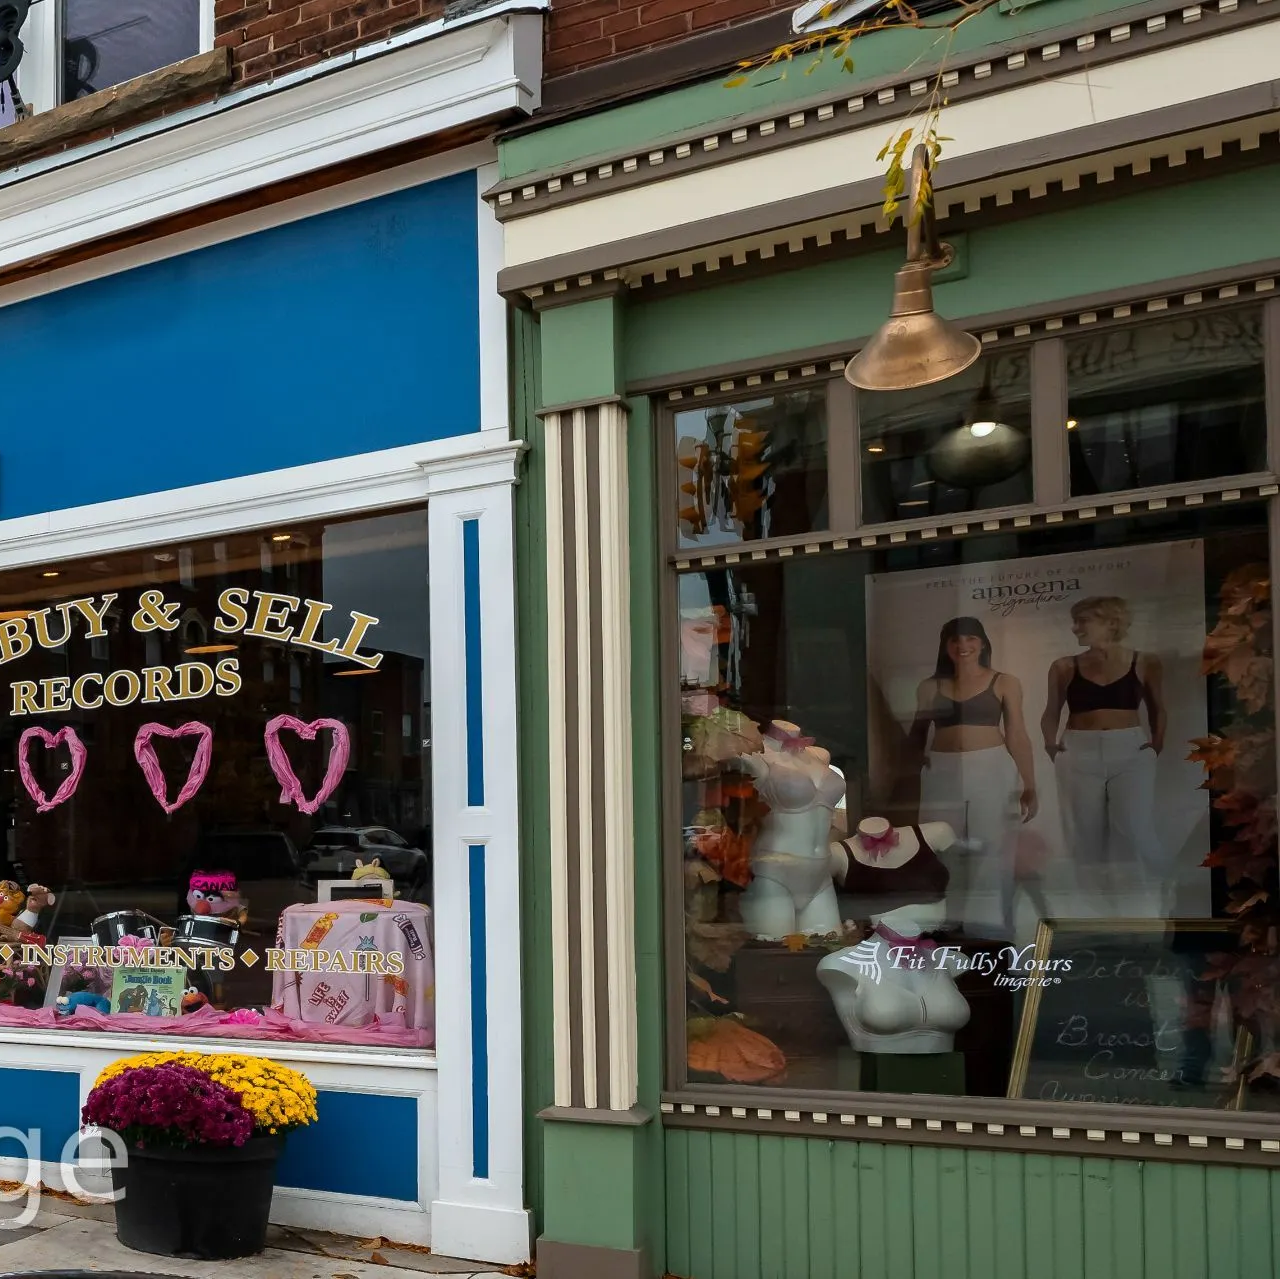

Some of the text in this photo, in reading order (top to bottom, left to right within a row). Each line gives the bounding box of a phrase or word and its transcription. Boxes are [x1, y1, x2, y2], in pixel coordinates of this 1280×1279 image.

[972, 577, 1081, 600] amoena
[131, 589, 181, 632] &
[213, 587, 384, 669] SELL
[9, 658, 242, 717] RECORDS
[21, 943, 236, 971] INSTRUMENTS
[266, 947, 405, 974] REPAIRS
[886, 943, 1073, 976] Fit Fully Yours
[308, 981, 331, 1006] LIFE
[325, 989, 350, 1024] SWEET
[1056, 1015, 1187, 1051] Breast
